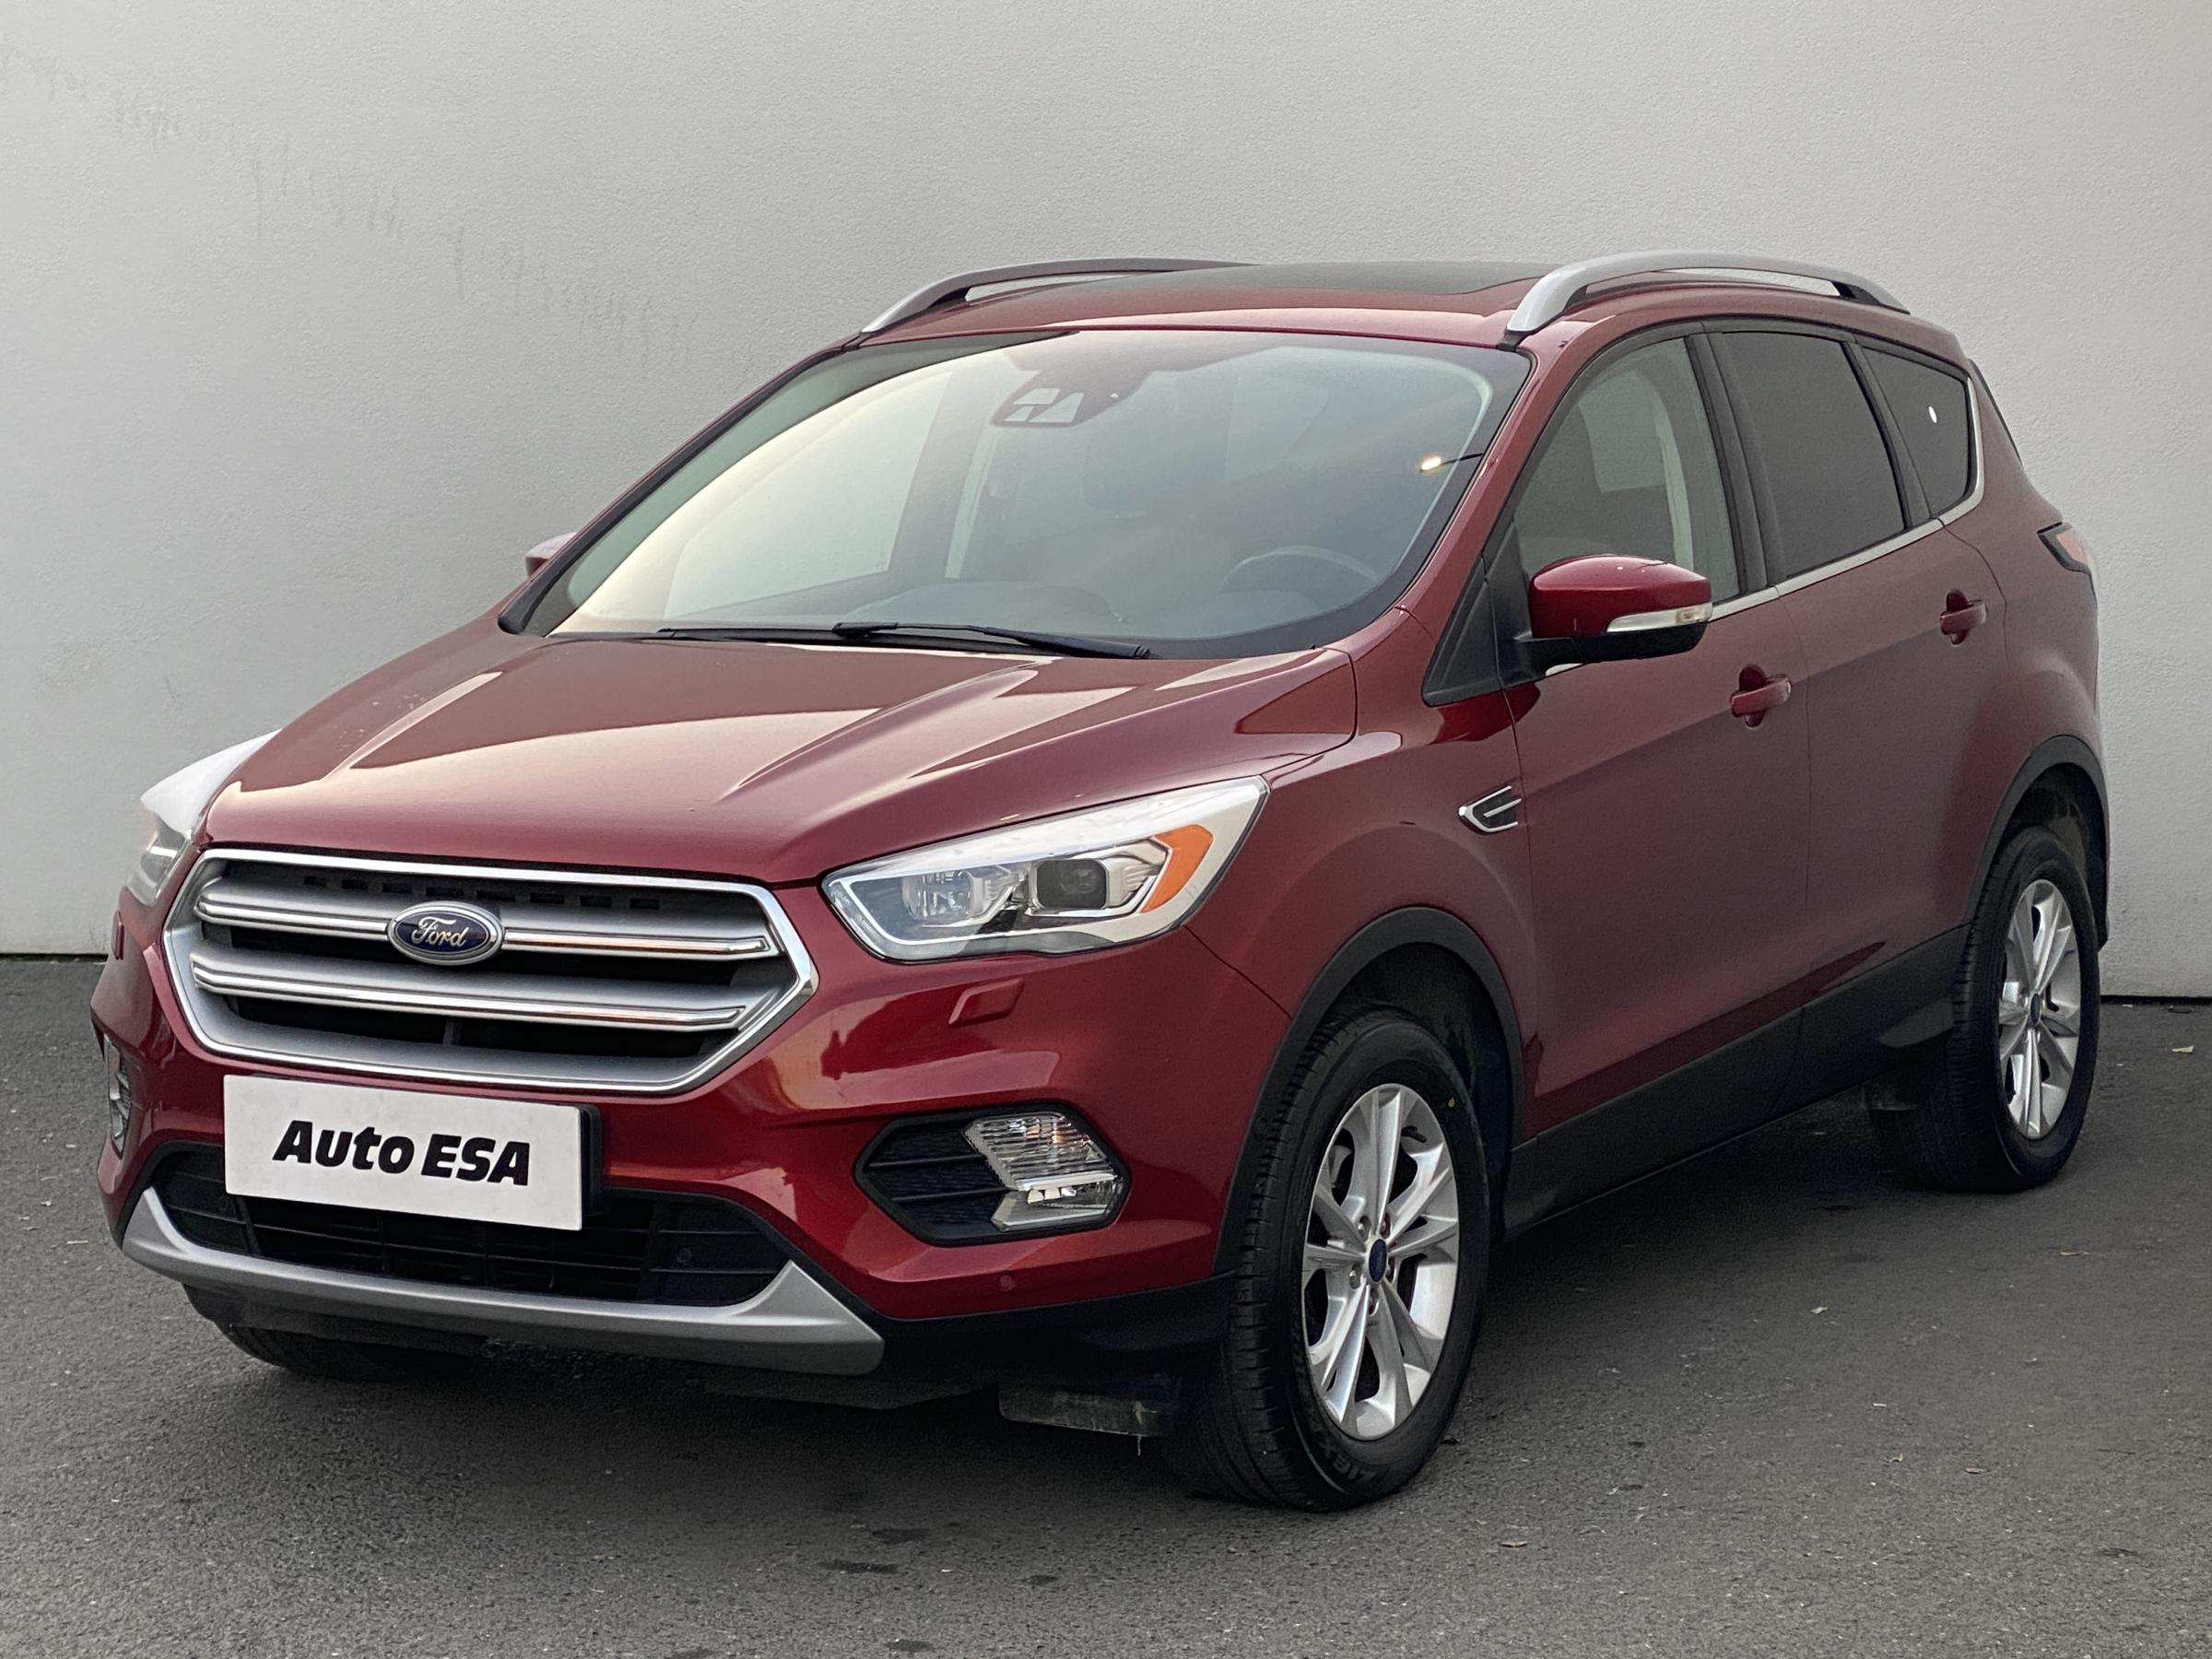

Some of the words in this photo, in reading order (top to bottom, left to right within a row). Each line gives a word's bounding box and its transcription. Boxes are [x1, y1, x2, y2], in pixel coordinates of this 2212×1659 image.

[411, 916, 469, 947] Ford
[272, 1120, 415, 1174] Auto
[421, 1134, 530, 1186] ESA
